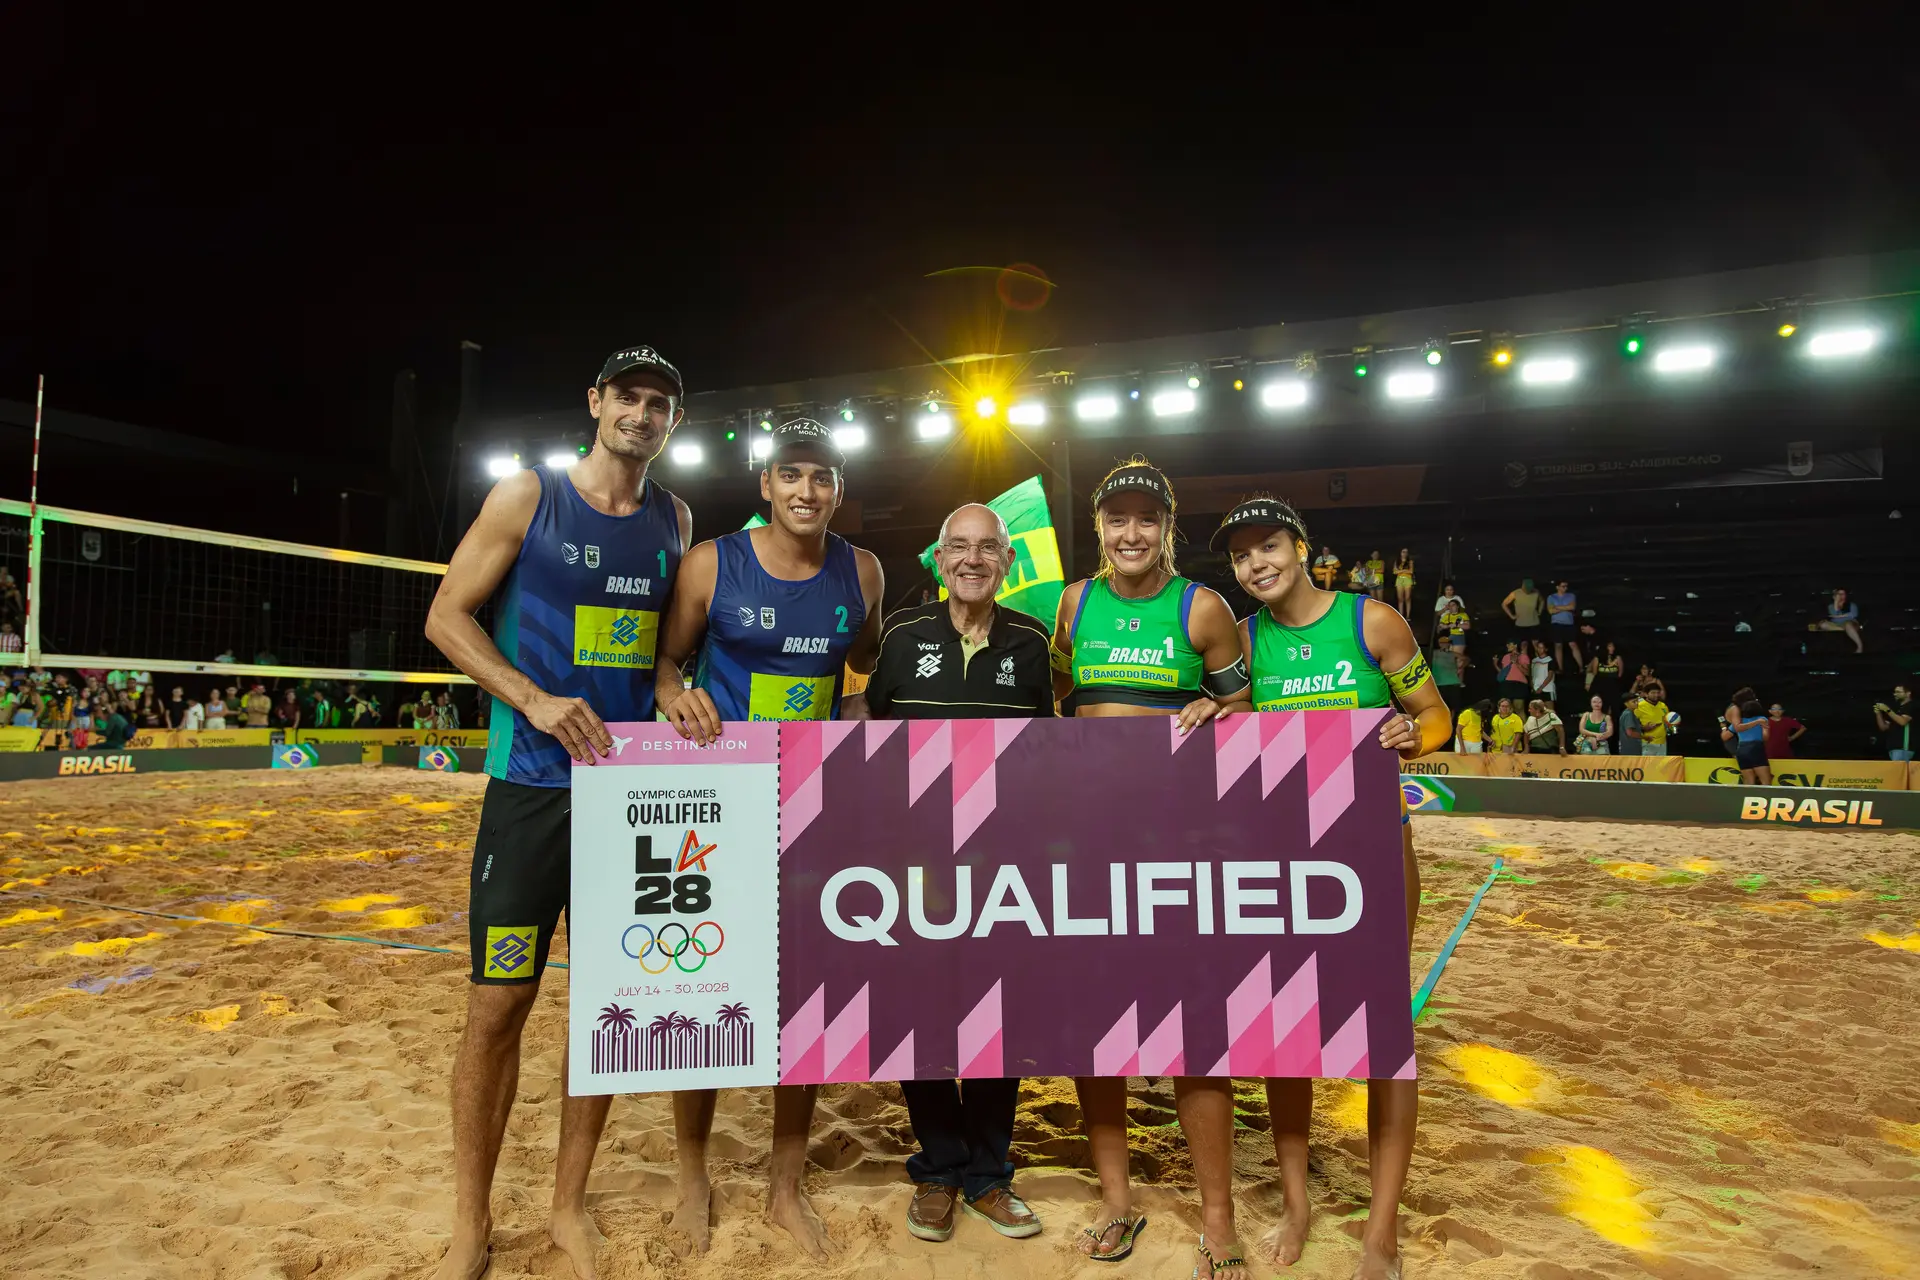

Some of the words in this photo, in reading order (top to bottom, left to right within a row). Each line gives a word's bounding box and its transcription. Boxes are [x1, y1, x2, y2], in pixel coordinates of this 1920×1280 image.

[636, 356, 656, 364] MODA
[1107, 476, 1159, 491] ZINZANE
[1227, 508, 1268, 524] NZANE
[657, 549, 666, 578] 1
[605, 575, 651, 596] BRASIL
[835, 605, 849, 633] 2
[782, 636, 830, 654] BRASIL
[917, 643, 940, 651] VOLT
[1163, 636, 1174, 659] 1
[579, 649, 616, 662] BANCO
[618, 653, 632, 664] DO
[1108, 648, 1164, 666] BRASIL
[1094, 669, 1126, 679] BANCO
[1126, 670, 1140, 679] DO
[1141, 670, 1174, 682] BRASIL
[1336, 660, 1356, 686] 2
[1282, 674, 1336, 696] BRASIL
[1271, 702, 1303, 712] BANCO
[1304, 700, 1317, 708] DO
[1318, 698, 1354, 708] BRASIL
[58, 755, 136, 775] BRASIL
[1400, 762, 1450, 775] VERNO
[1559, 768, 1644, 782] GOVERNO
[627, 790, 676, 800] OLYMPIC
[678, 789, 716, 798] GAMES
[627, 802, 722, 828] QUALIFIER
[1740, 796, 1883, 826] BRASIL
[635, 830, 718, 874] LA
[634, 874, 712, 915] 28
[820, 860, 1364, 946] QUALIFIED
[614, 986, 642, 997] JULY
[644, 985, 660, 996] 14
[674, 984, 694, 995] 30,
[696, 982, 730, 994] 2028
